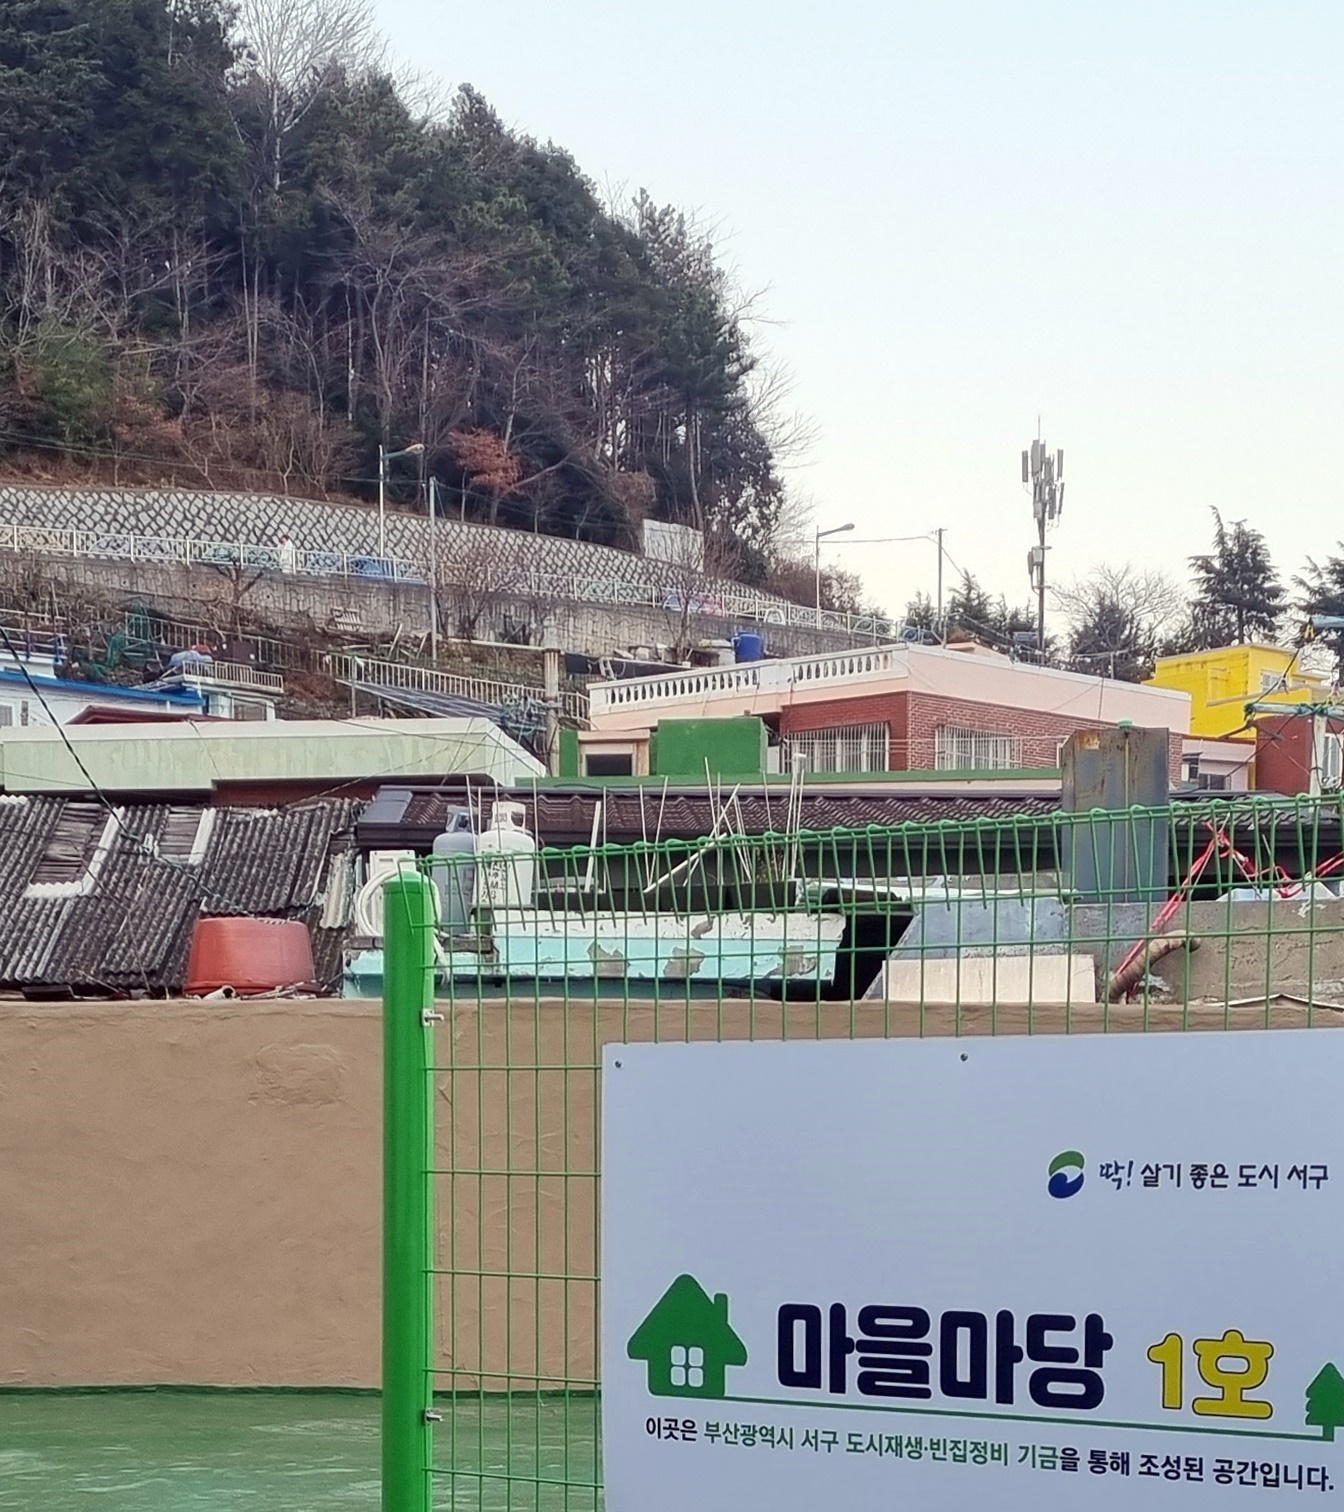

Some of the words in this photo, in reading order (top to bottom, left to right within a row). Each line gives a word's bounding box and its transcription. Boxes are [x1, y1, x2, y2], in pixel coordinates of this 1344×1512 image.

[1099, 1160, 1134, 1191] 딱!
[1139, 1162, 1182, 1188] 살기
[1189, 1162, 1230, 1190] 좋은
[1237, 1164, 1279, 1189] 도시
[1287, 1164, 1329, 1190] 서구
[777, 1302, 1114, 1410] 마을마당
[1146, 1329, 1275, 1421] 1호
[645, 1417, 698, 1443] 이곳은
[703, 1420, 794, 1450] 부산광역시
[800, 1428, 840, 1453] 서구
[1017, 1444, 1081, 1472] 기금을
[1087, 1449, 1130, 1477] 통해
[1137, 1453, 1205, 1482] 조성된
[1212, 1458, 1335, 1492] 공간입니다.
